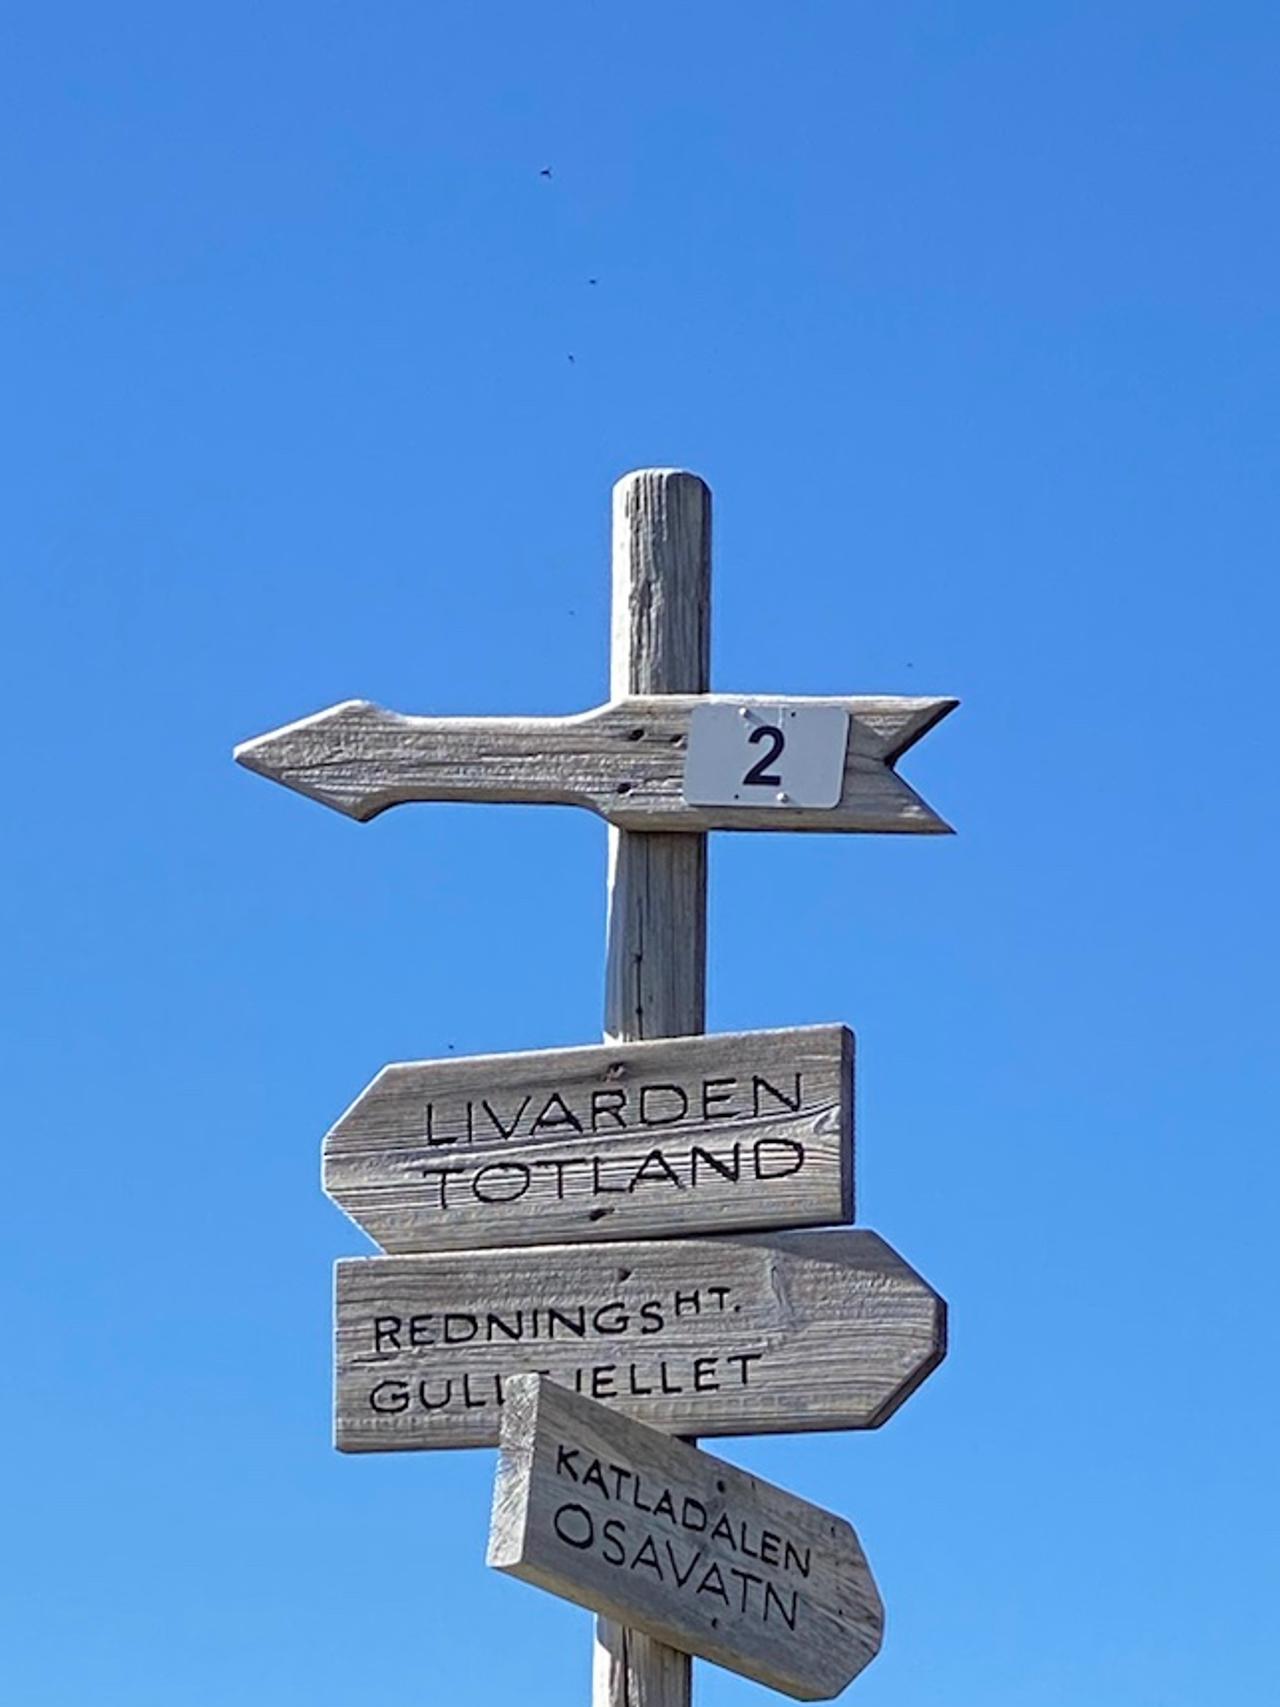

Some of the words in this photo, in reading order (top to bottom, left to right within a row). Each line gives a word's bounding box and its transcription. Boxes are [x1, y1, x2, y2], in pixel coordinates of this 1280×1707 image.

[742, 725, 785, 786] 2
[425, 1072, 803, 1146] LIVARDEN
[423, 1137, 805, 1210] TOTLAND
[369, 1353, 763, 1414] GULLJELLET
[556, 1444, 811, 1578] KATLADALEN
[553, 1503, 799, 1631] OSAVATN
